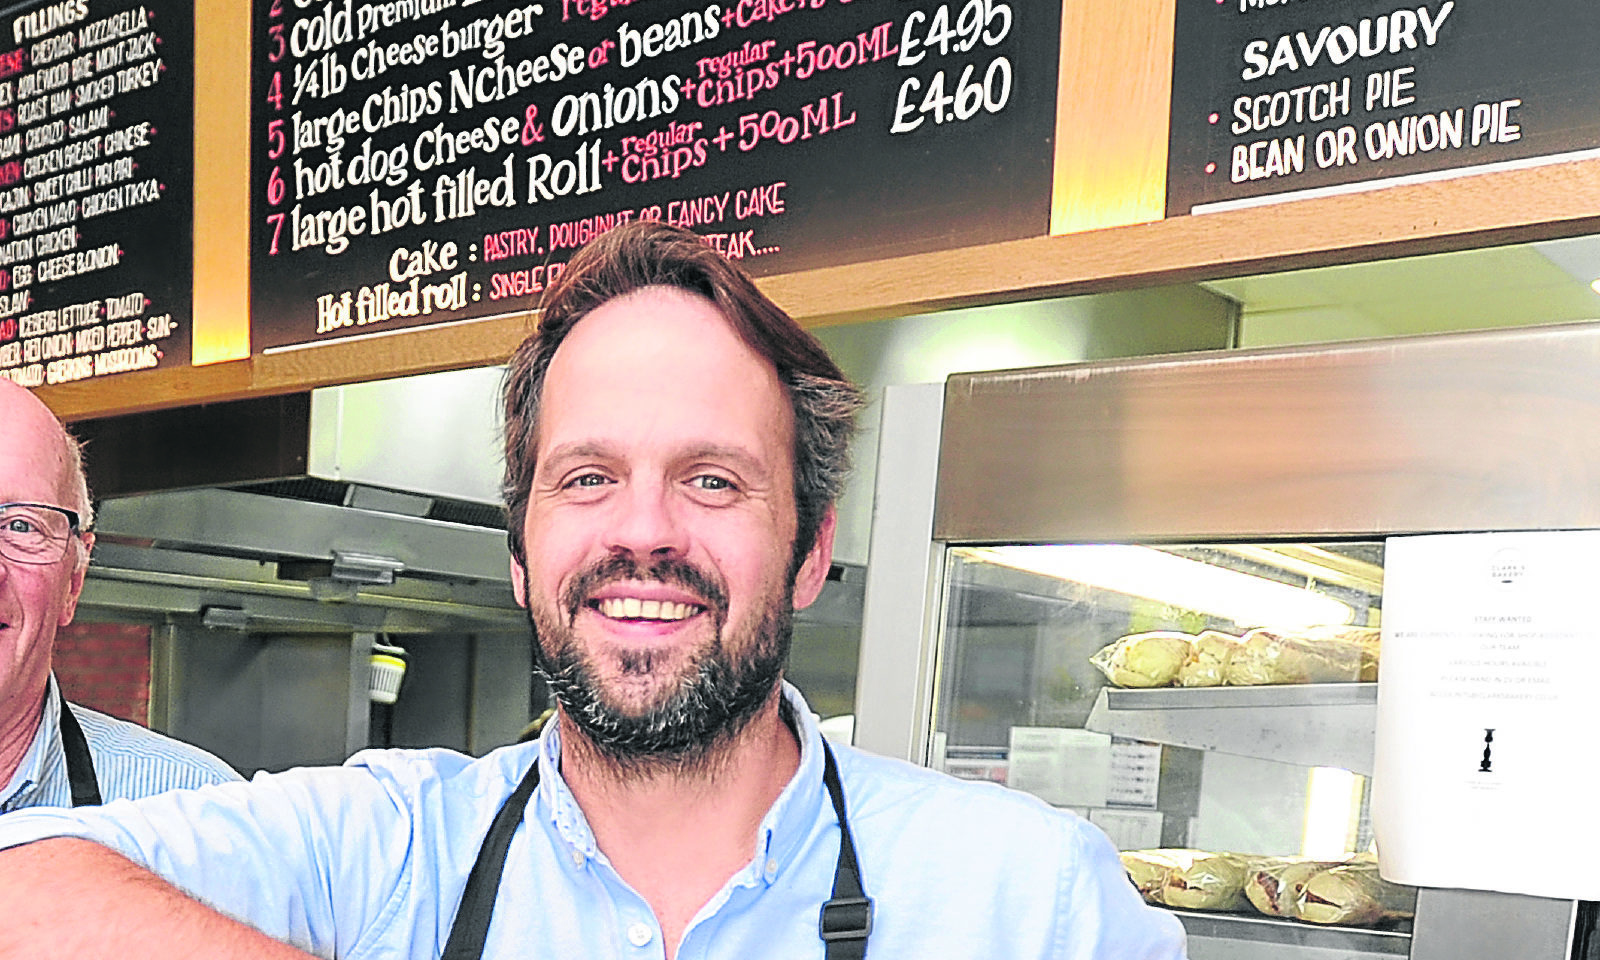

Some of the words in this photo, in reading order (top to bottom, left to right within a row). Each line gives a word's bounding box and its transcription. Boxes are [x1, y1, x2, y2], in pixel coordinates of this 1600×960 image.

[13, 0, 89, 43] FILLINGS
[31, 31, 75, 66] CHEDDAR
[78, 6, 148, 49] MOZZARELLA
[125, 31, 156, 62] JACK
[268, 24, 286, 62] 3
[1241, 1, 1454, 80] SAVOURY
[17, 96, 48, 126] ROAST
[50, 88, 72, 117] HAM
[75, 75, 115, 108] SMOKED
[117, 58, 162, 93] TURKEY
[267, 71, 284, 111] 4
[267, 165, 285, 206] 6
[293, 151, 343, 200] hot
[347, 137, 409, 187] dog
[521, 103, 545, 146] &
[696, 40, 776, 79] regular
[897, 0, 1013, 66] £4.95
[268, 119, 285, 159] 5
[291, 107, 360, 153] large
[588, 38, 616, 69] or
[617, 4, 721, 68] beans
[1231, 78, 1350, 135] SCOTCH
[1365, 66, 1415, 112] PIE
[24, 148, 63, 179] CHICKEN
[64, 136, 102, 168] BREAST
[104, 121, 150, 156] CHINESE
[25, 119, 64, 151] CHORIZO
[69, 105, 109, 138] SALAMI
[1230, 136, 1304, 184] BEAN
[1315, 126, 1357, 169] OR
[1365, 109, 1463, 160] ONION
[1472, 99, 1521, 143] PIE
[266, 213, 285, 255] 7
[291, 204, 366, 255] large
[370, 179, 427, 235] hot
[432, 153, 517, 223] filled
[527, 138, 602, 205] Roll
[620, 120, 703, 157] regular
[890, 56, 1012, 134] £4.60
[0, 185, 31, 214] CAJUN
[34, 174, 65, 203] SWEET
[13, 207, 49, 236] CHICKEN
[50, 200, 77, 225] MAYO
[81, 187, 124, 219] CHICKEN
[125, 178, 160, 207] TIKKA
[668, 191, 730, 229] FANCY
[735, 182, 787, 221] CAKE
[36, 225, 78, 256] CHICKEN
[12, 264, 33, 290] EGG
[37, 251, 76, 283] CHEESE
[316, 292, 354, 335] Hot
[355, 276, 420, 326] filled
[421, 271, 468, 315] roll
[489, 265, 545, 301] SINGLE
[701, 229, 780, 260] TEAK....
[19, 309, 57, 339] ICEBERG
[57, 300, 101, 332] LETTUCE
[105, 292, 145, 321] TOMATO
[23, 337, 41, 363] RED
[41, 331, 75, 361] ONION
[75, 325, 105, 355] MIXED
[106, 319, 143, 348] PEPPER
